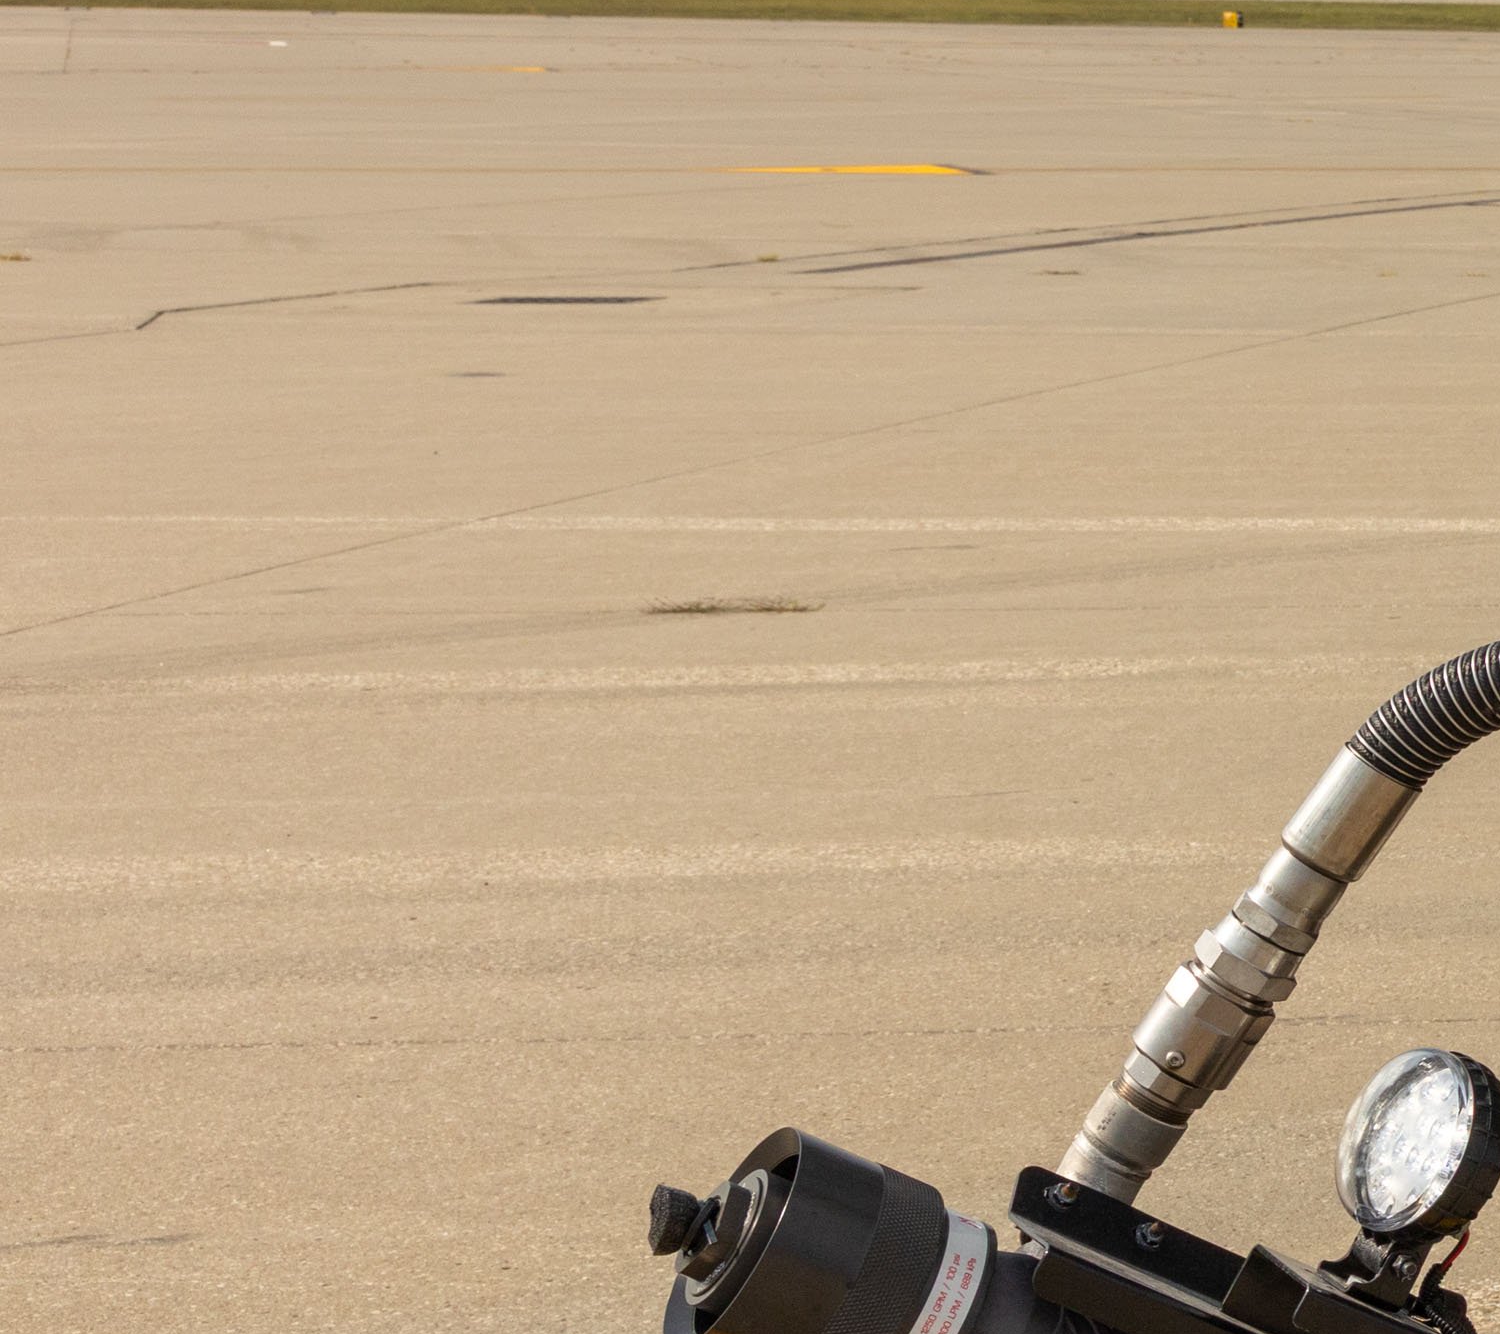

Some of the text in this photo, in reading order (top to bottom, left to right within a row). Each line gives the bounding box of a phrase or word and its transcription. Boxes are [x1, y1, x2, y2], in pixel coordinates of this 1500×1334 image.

[933, 1291, 947, 1312] GPM
[947, 1266, 958, 1281] 100
[950, 1300, 964, 1321] LPM
[960, 1272, 973, 1290] 689
